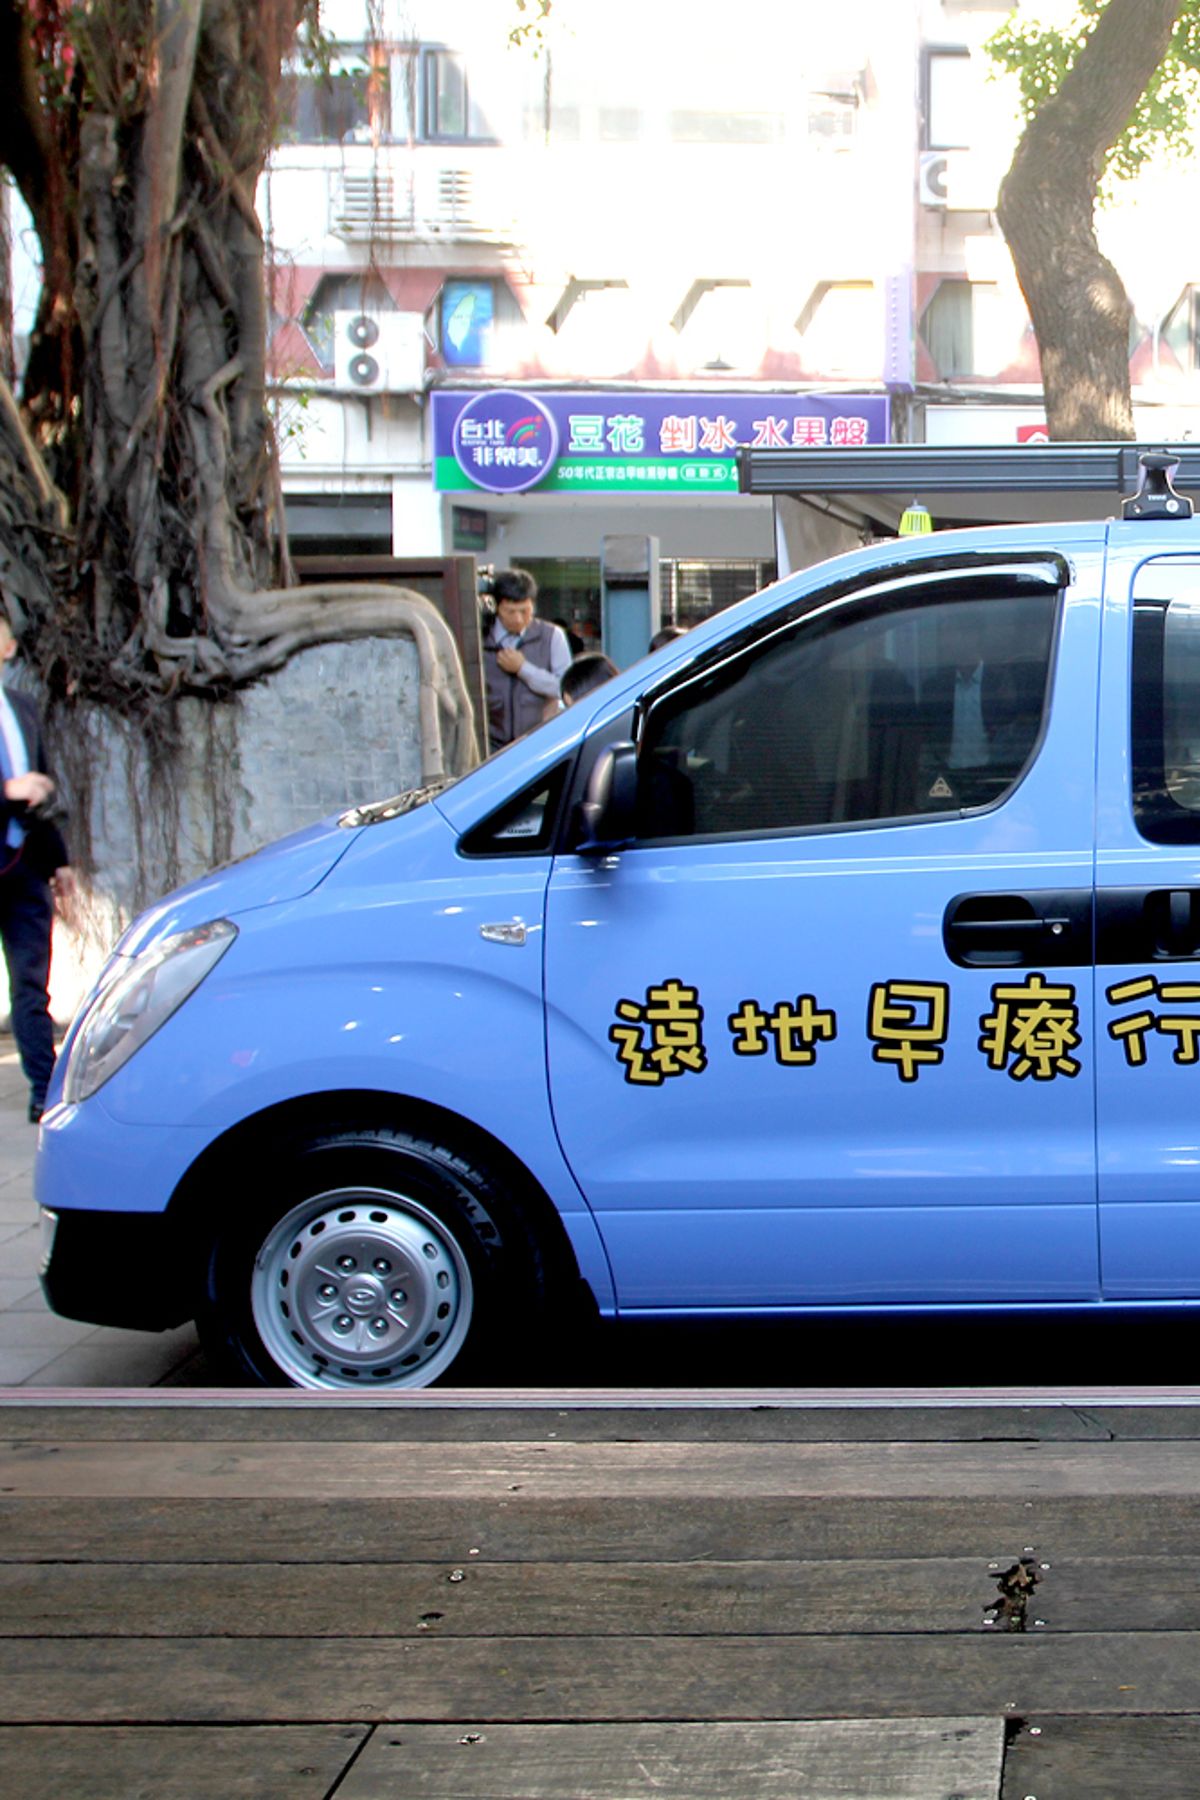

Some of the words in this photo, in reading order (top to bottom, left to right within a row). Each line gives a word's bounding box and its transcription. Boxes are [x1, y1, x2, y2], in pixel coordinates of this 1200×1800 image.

[461, 418, 505, 440] 台北
[567, 414, 644, 452] 豆花
[660, 415, 736, 452] 剉冰
